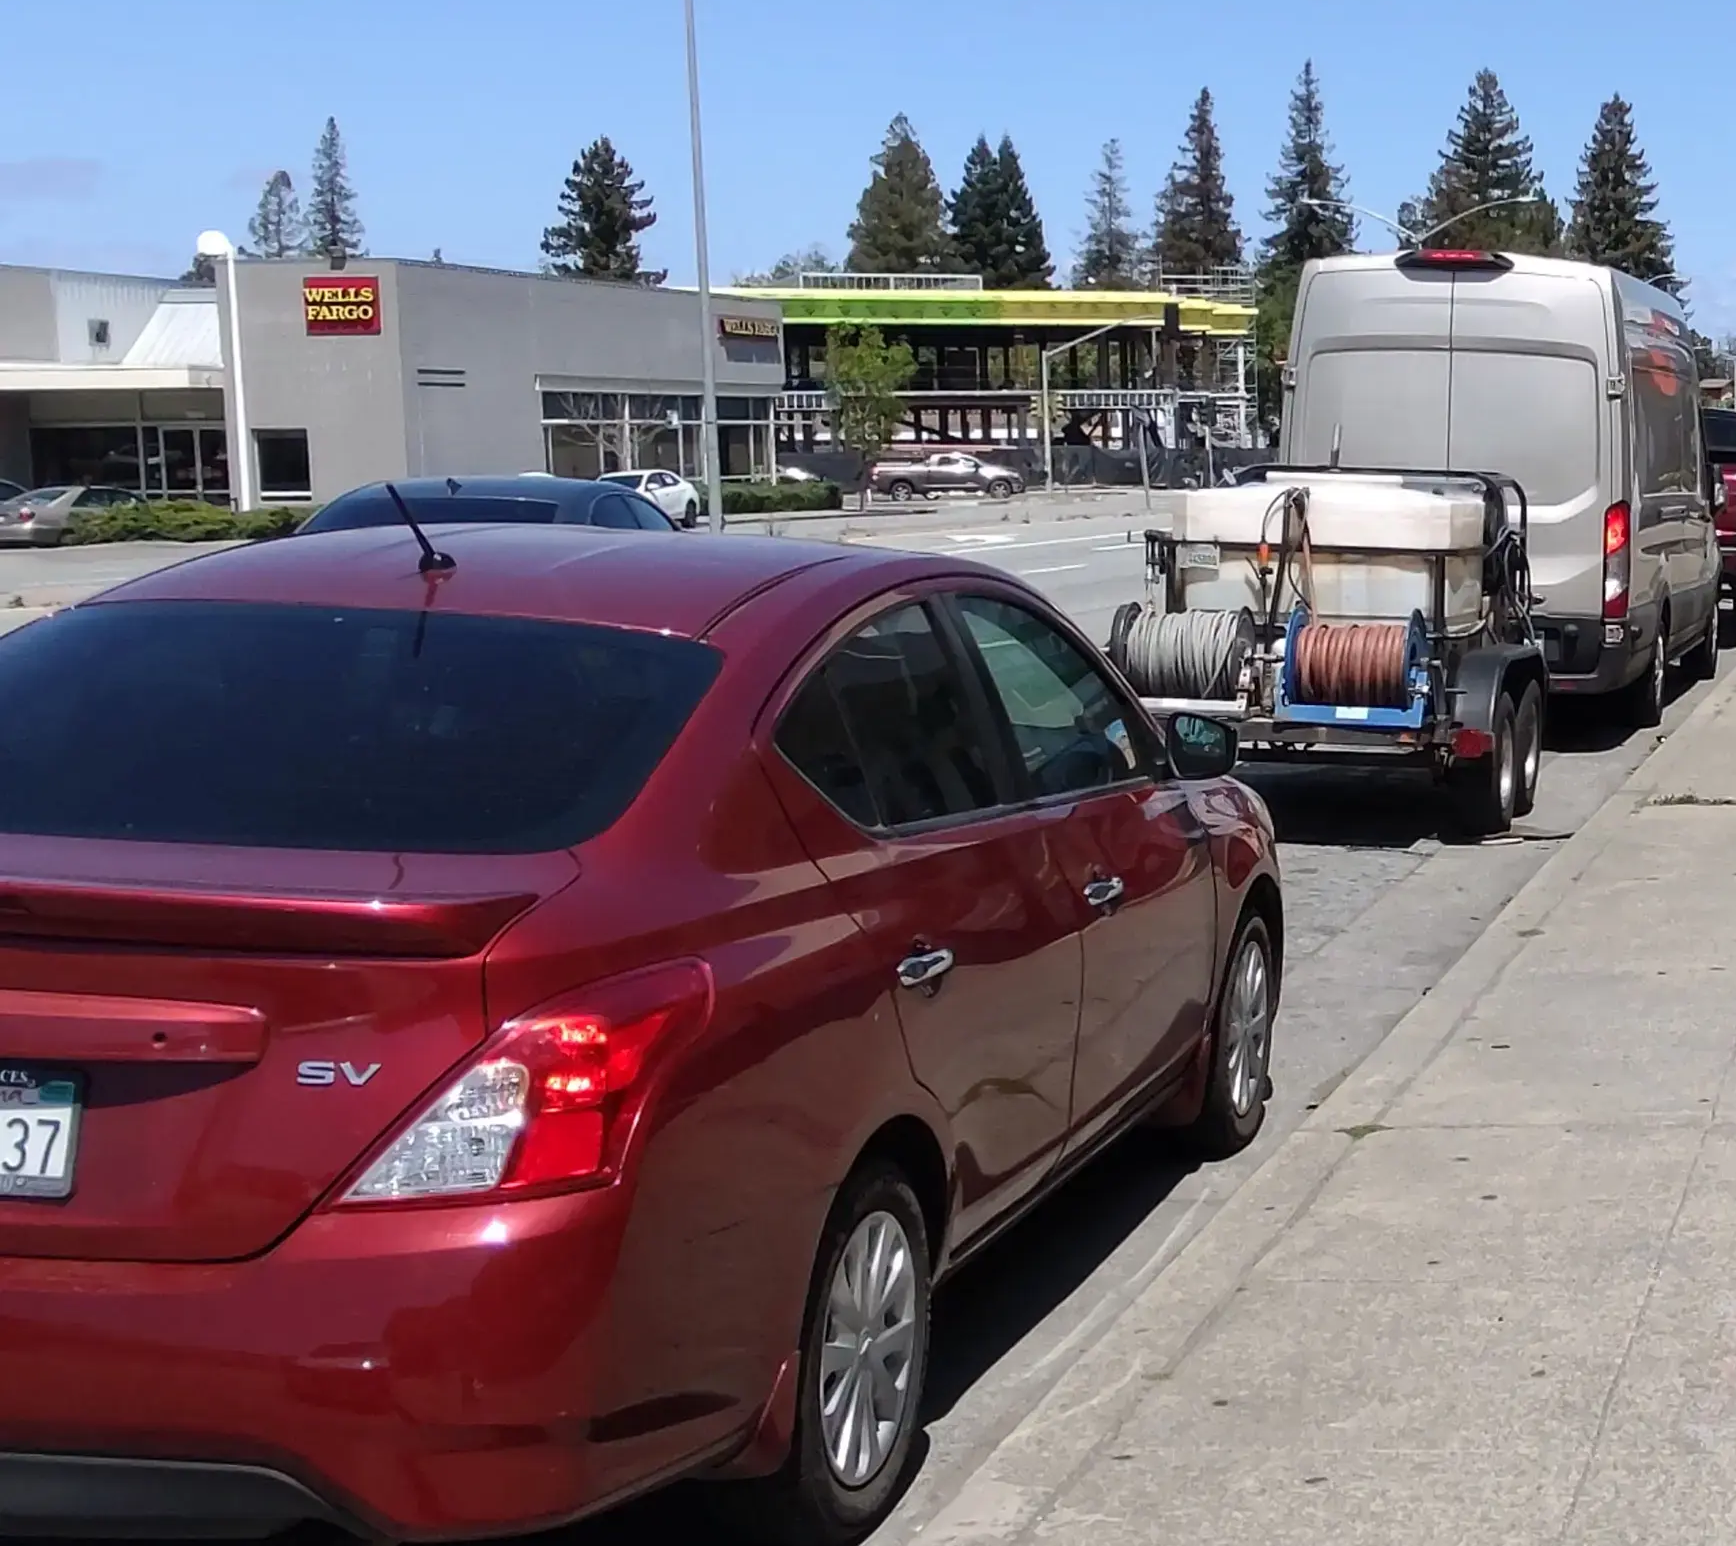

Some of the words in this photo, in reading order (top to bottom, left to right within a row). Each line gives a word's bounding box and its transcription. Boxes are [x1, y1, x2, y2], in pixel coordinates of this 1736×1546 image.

[303, 287, 374, 302] WELLS
[307, 305, 374, 320] FARGO
[295, 1061, 383, 1087] SV
[1, 1117, 61, 1175] 37
